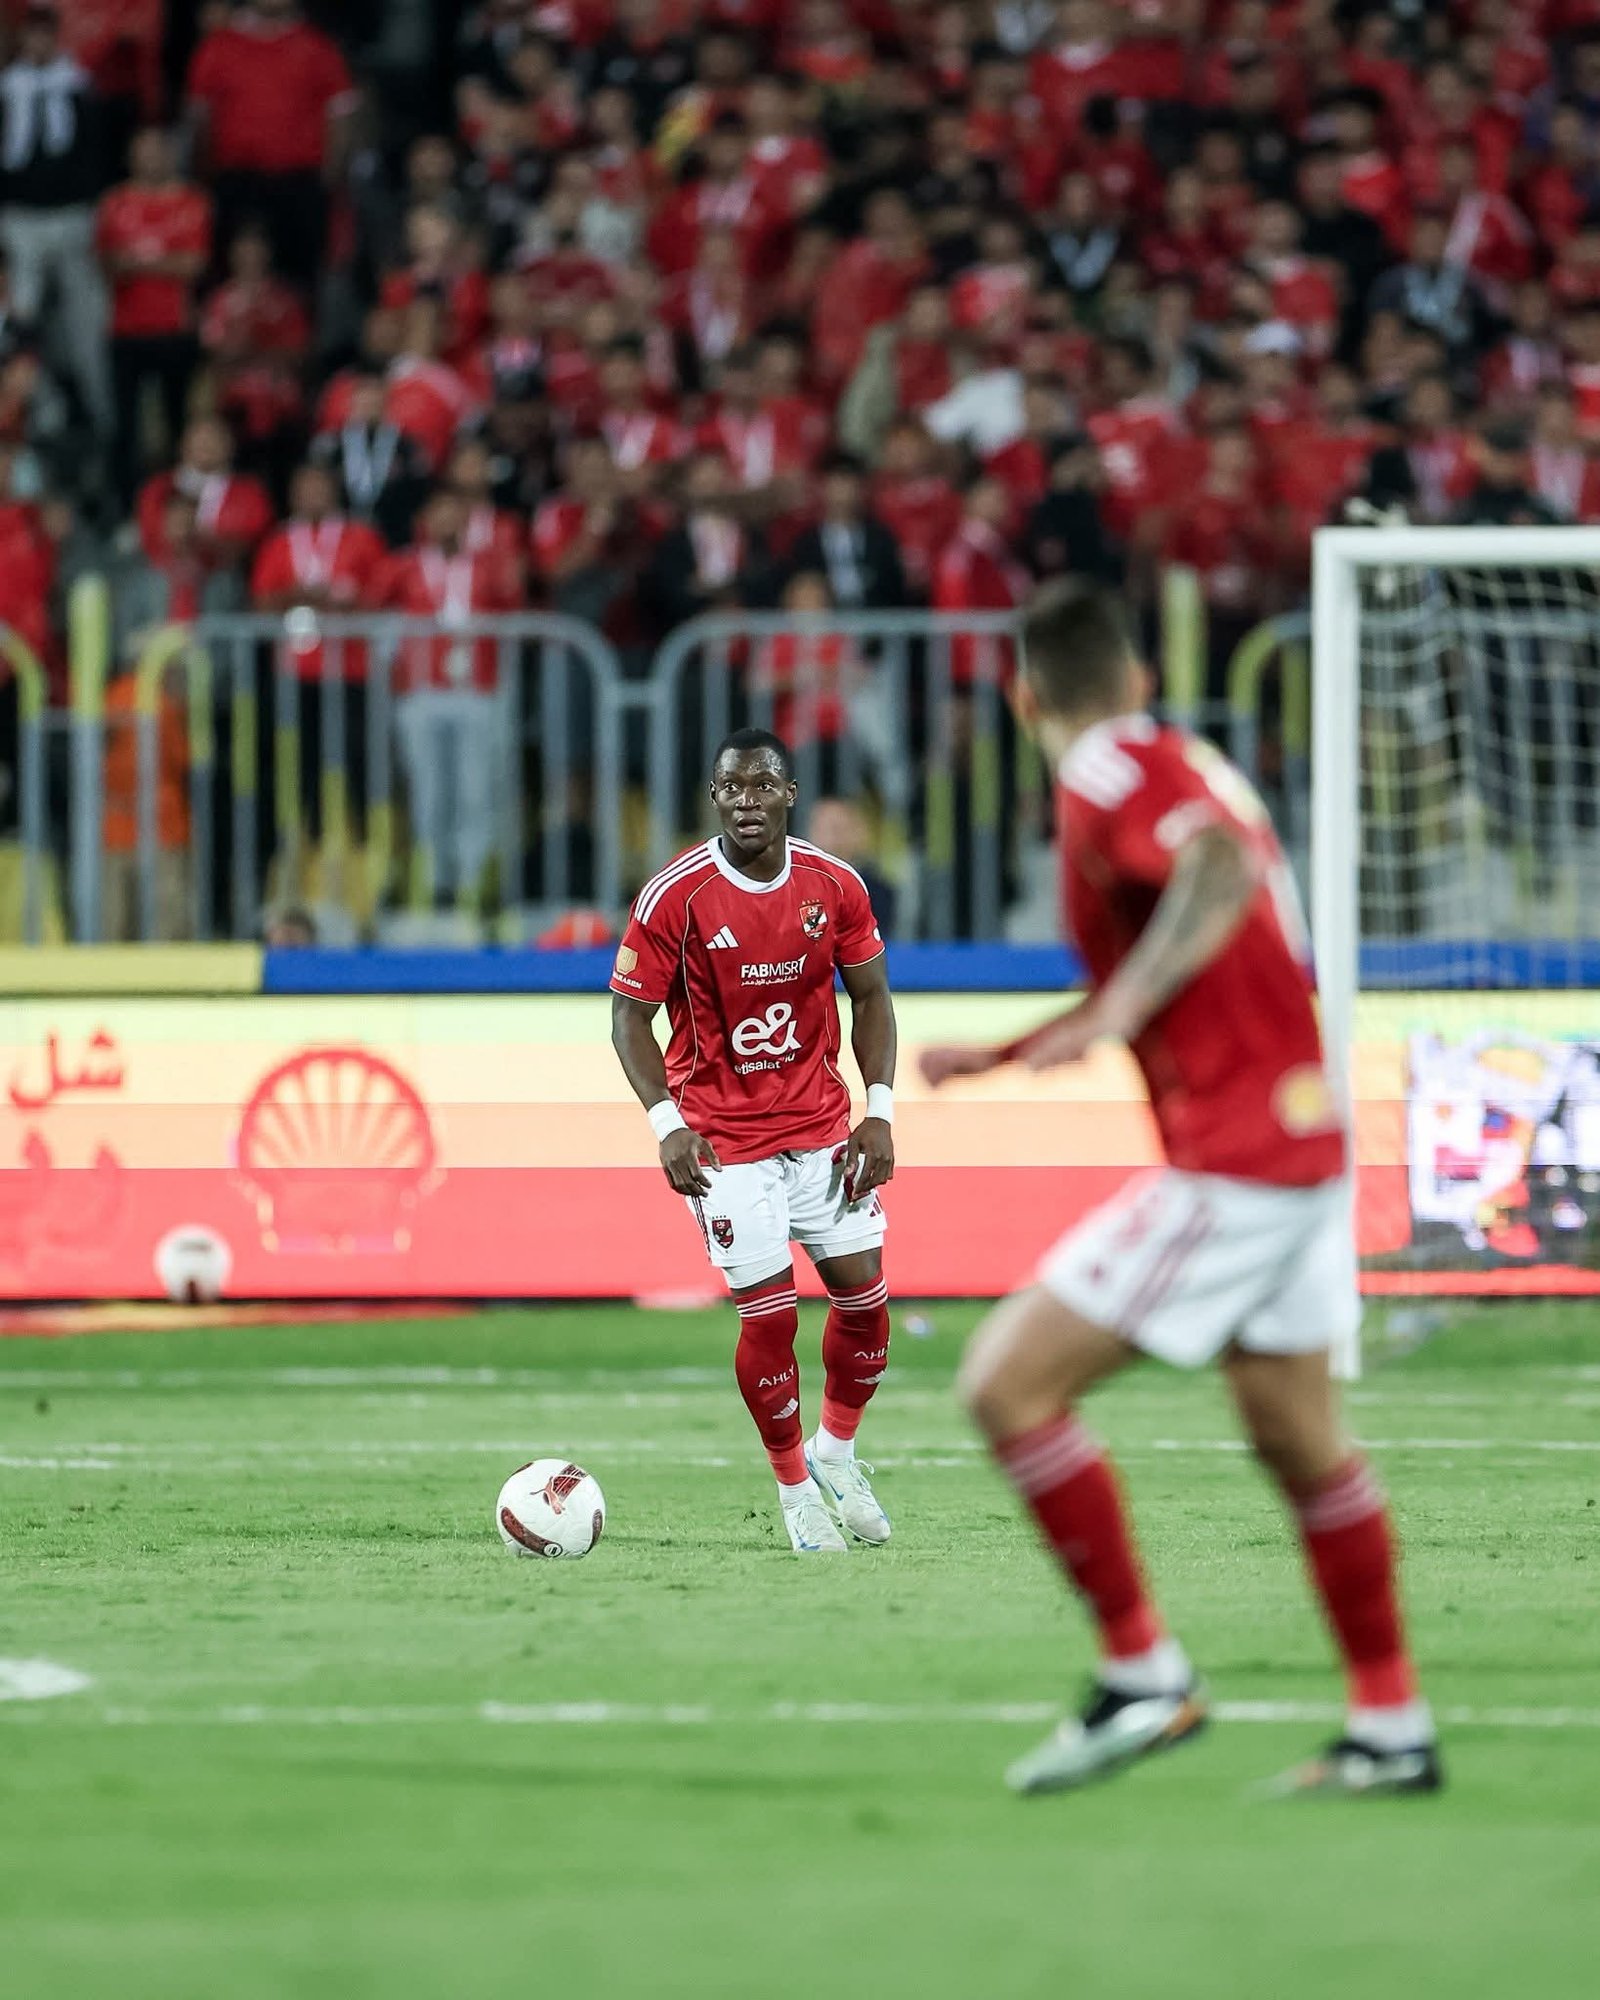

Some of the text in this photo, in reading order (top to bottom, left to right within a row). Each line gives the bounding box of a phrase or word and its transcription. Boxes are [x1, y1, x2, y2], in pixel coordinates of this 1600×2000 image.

[741, 960, 799, 979] FABMISR
[732, 1002, 802, 1056] e&
[758, 1364, 796, 1388] AHLY
